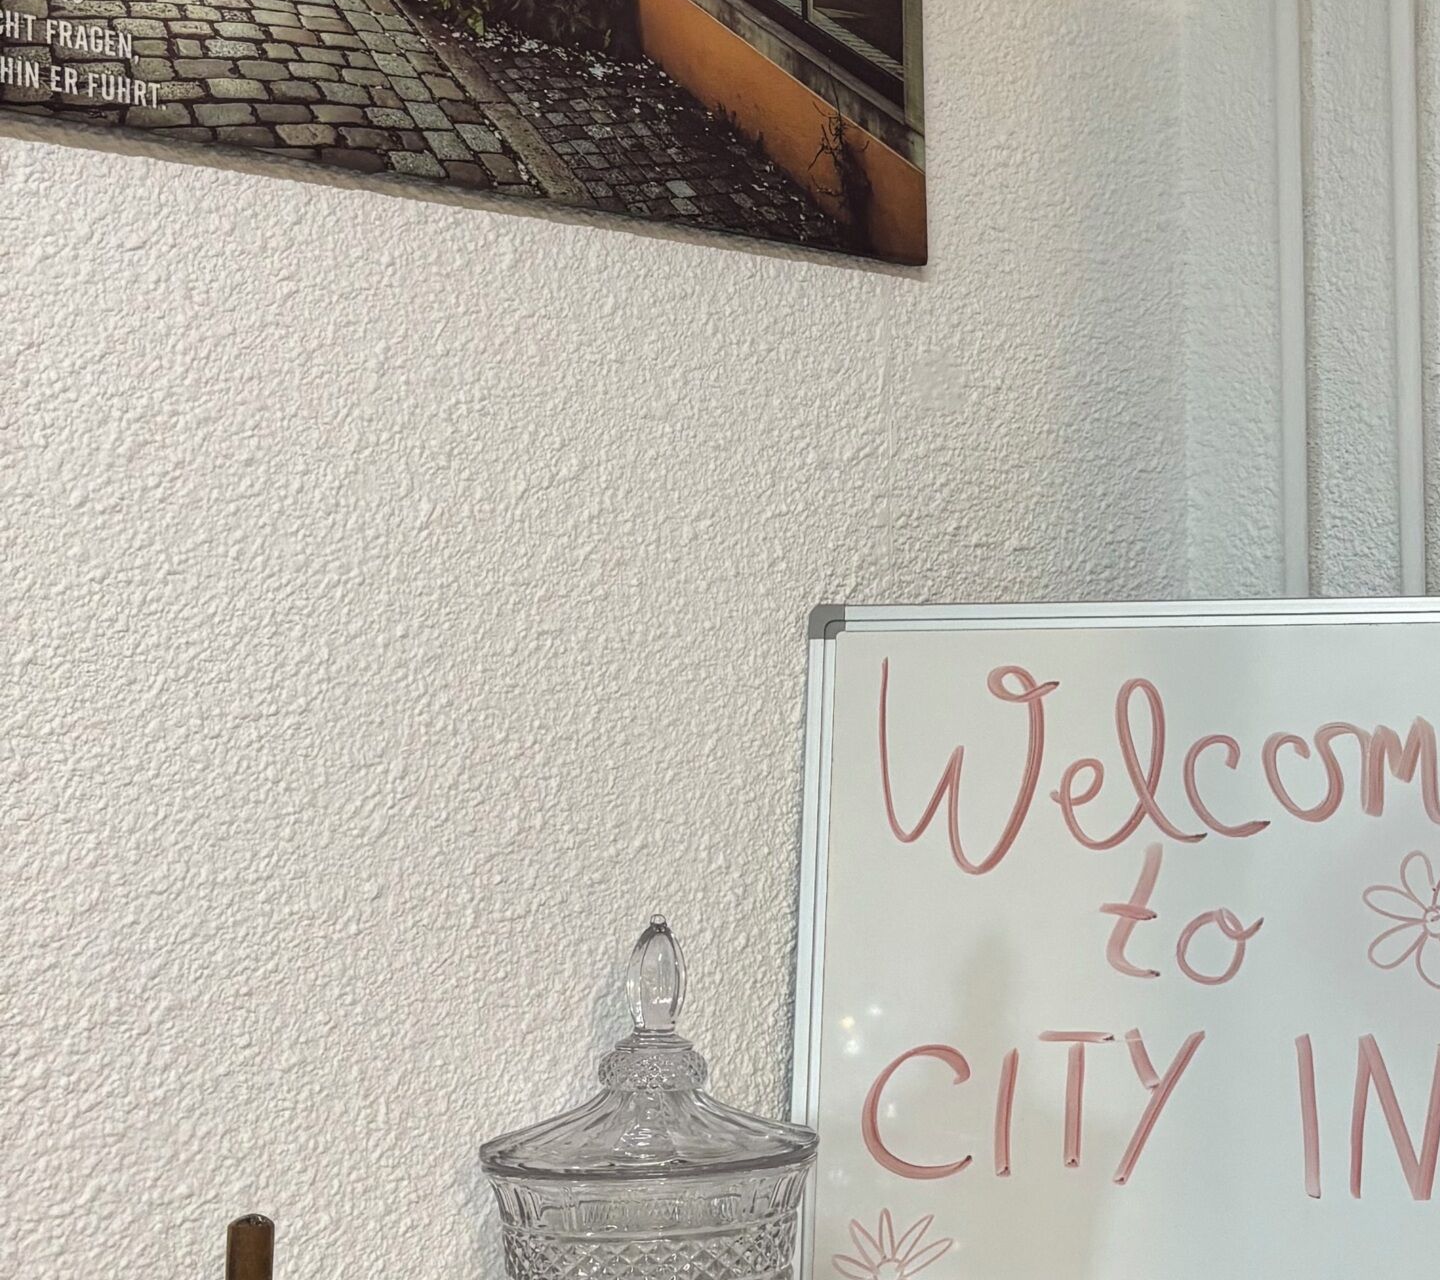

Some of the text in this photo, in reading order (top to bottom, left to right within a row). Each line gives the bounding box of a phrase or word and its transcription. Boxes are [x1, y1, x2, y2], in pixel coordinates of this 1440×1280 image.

[46, 19, 139, 64] FRAGEN,
[50, 65, 78, 95] ER
[88, 70, 167, 111] FÜHRT.
[1098, 842, 1265, 985] to
[861, 1028, 1206, 1184] CITY
